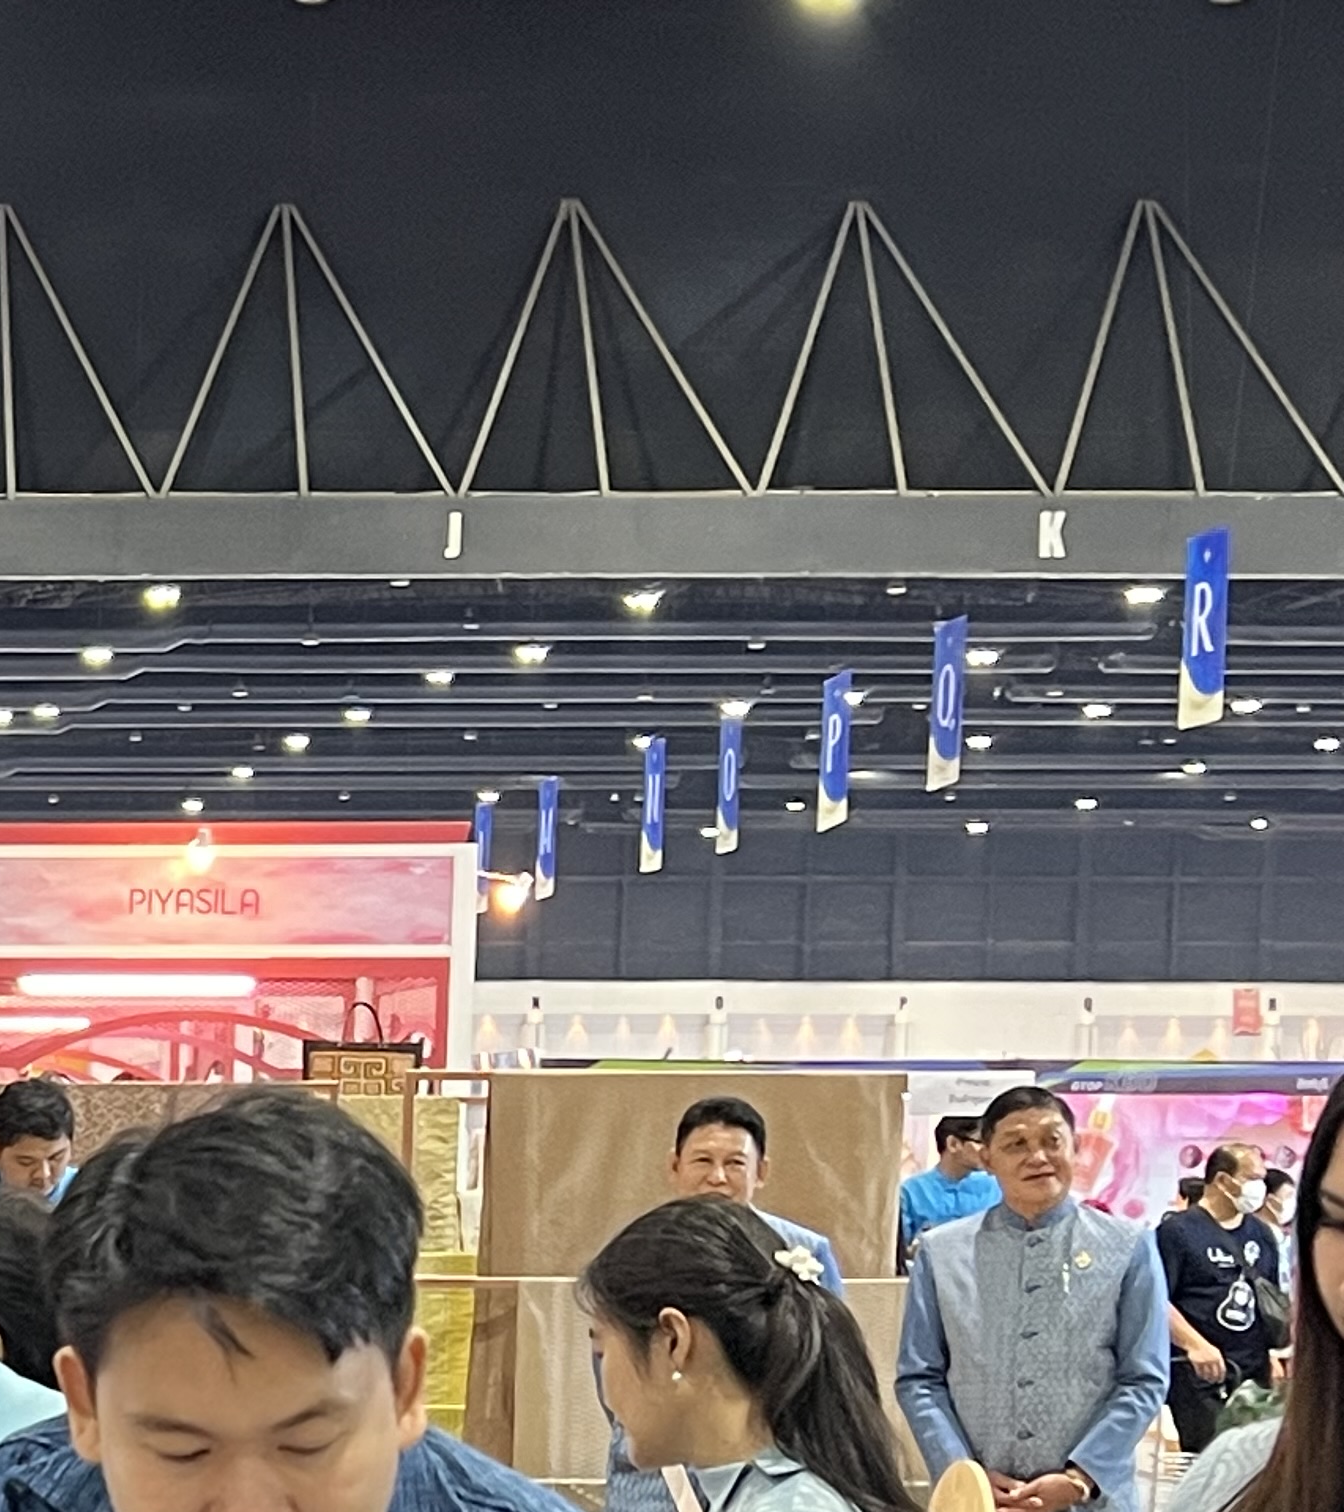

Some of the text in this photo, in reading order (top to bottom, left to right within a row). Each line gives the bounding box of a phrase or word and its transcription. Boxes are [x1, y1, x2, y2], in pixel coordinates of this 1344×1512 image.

[444, 511, 462, 559] J
[1038, 510, 1066, 558] K
[1191, 581, 1214, 657] R
[937, 663, 956, 731] Q
[826, 713, 842, 773] P
[129, 888, 260, 915] PIYASILA
